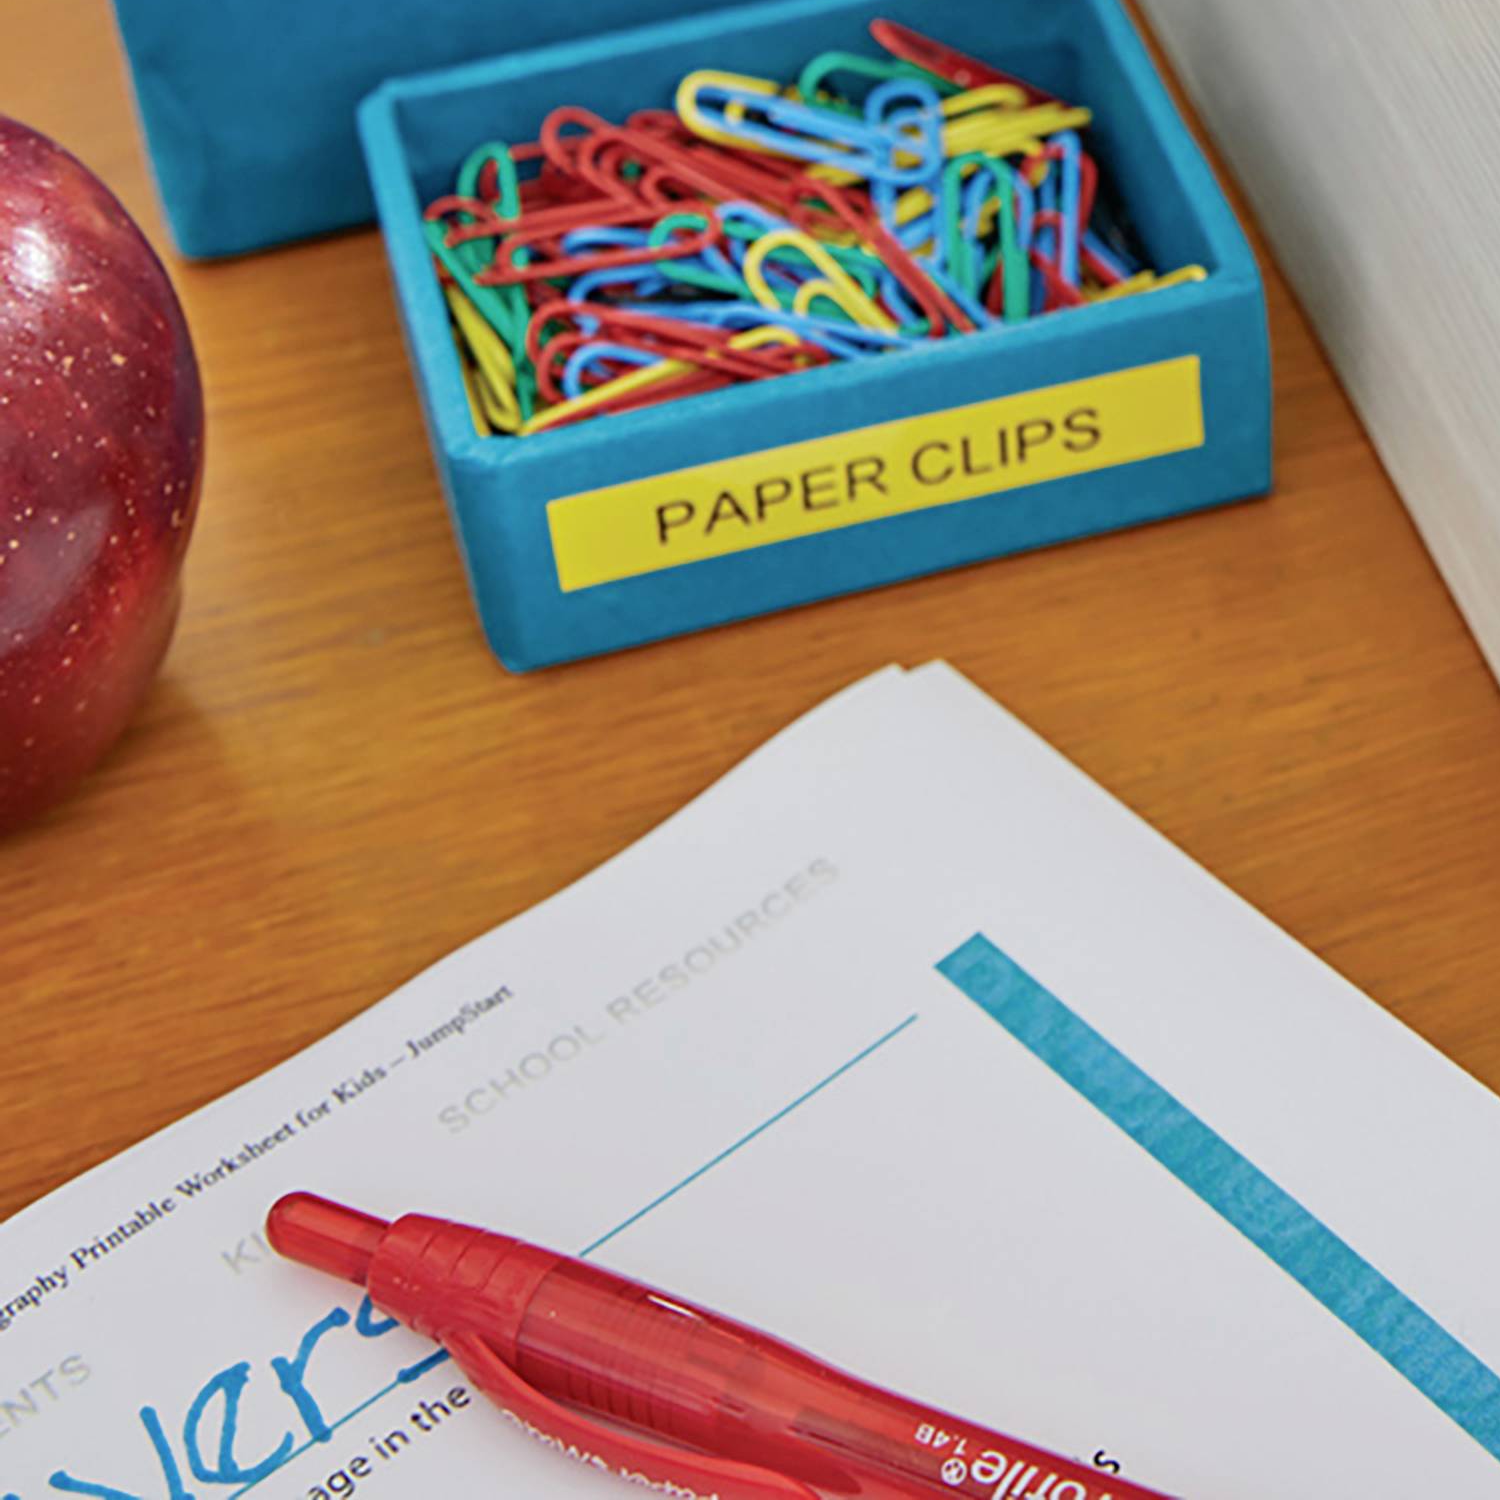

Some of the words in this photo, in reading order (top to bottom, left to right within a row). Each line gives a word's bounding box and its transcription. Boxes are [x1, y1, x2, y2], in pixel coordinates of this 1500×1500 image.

[655, 456, 889, 545] PAPER
[911, 407, 1102, 486] CLIPS
[438, 1024, 602, 1133] SCHOOL
[605, 858, 840, 1025] RESOURCES
[70, 1197, 176, 1269] Printable
[175, 1123, 296, 1198] Worksheet
[295, 1100, 331, 1129] for
[332, 1066, 387, 1104] Kids
[405, 985, 514, 1059] JumpStart
[303, 1456, 372, 1500] age
[368, 1430, 410, 1460] in
[410, 1386, 471, 1431] the
